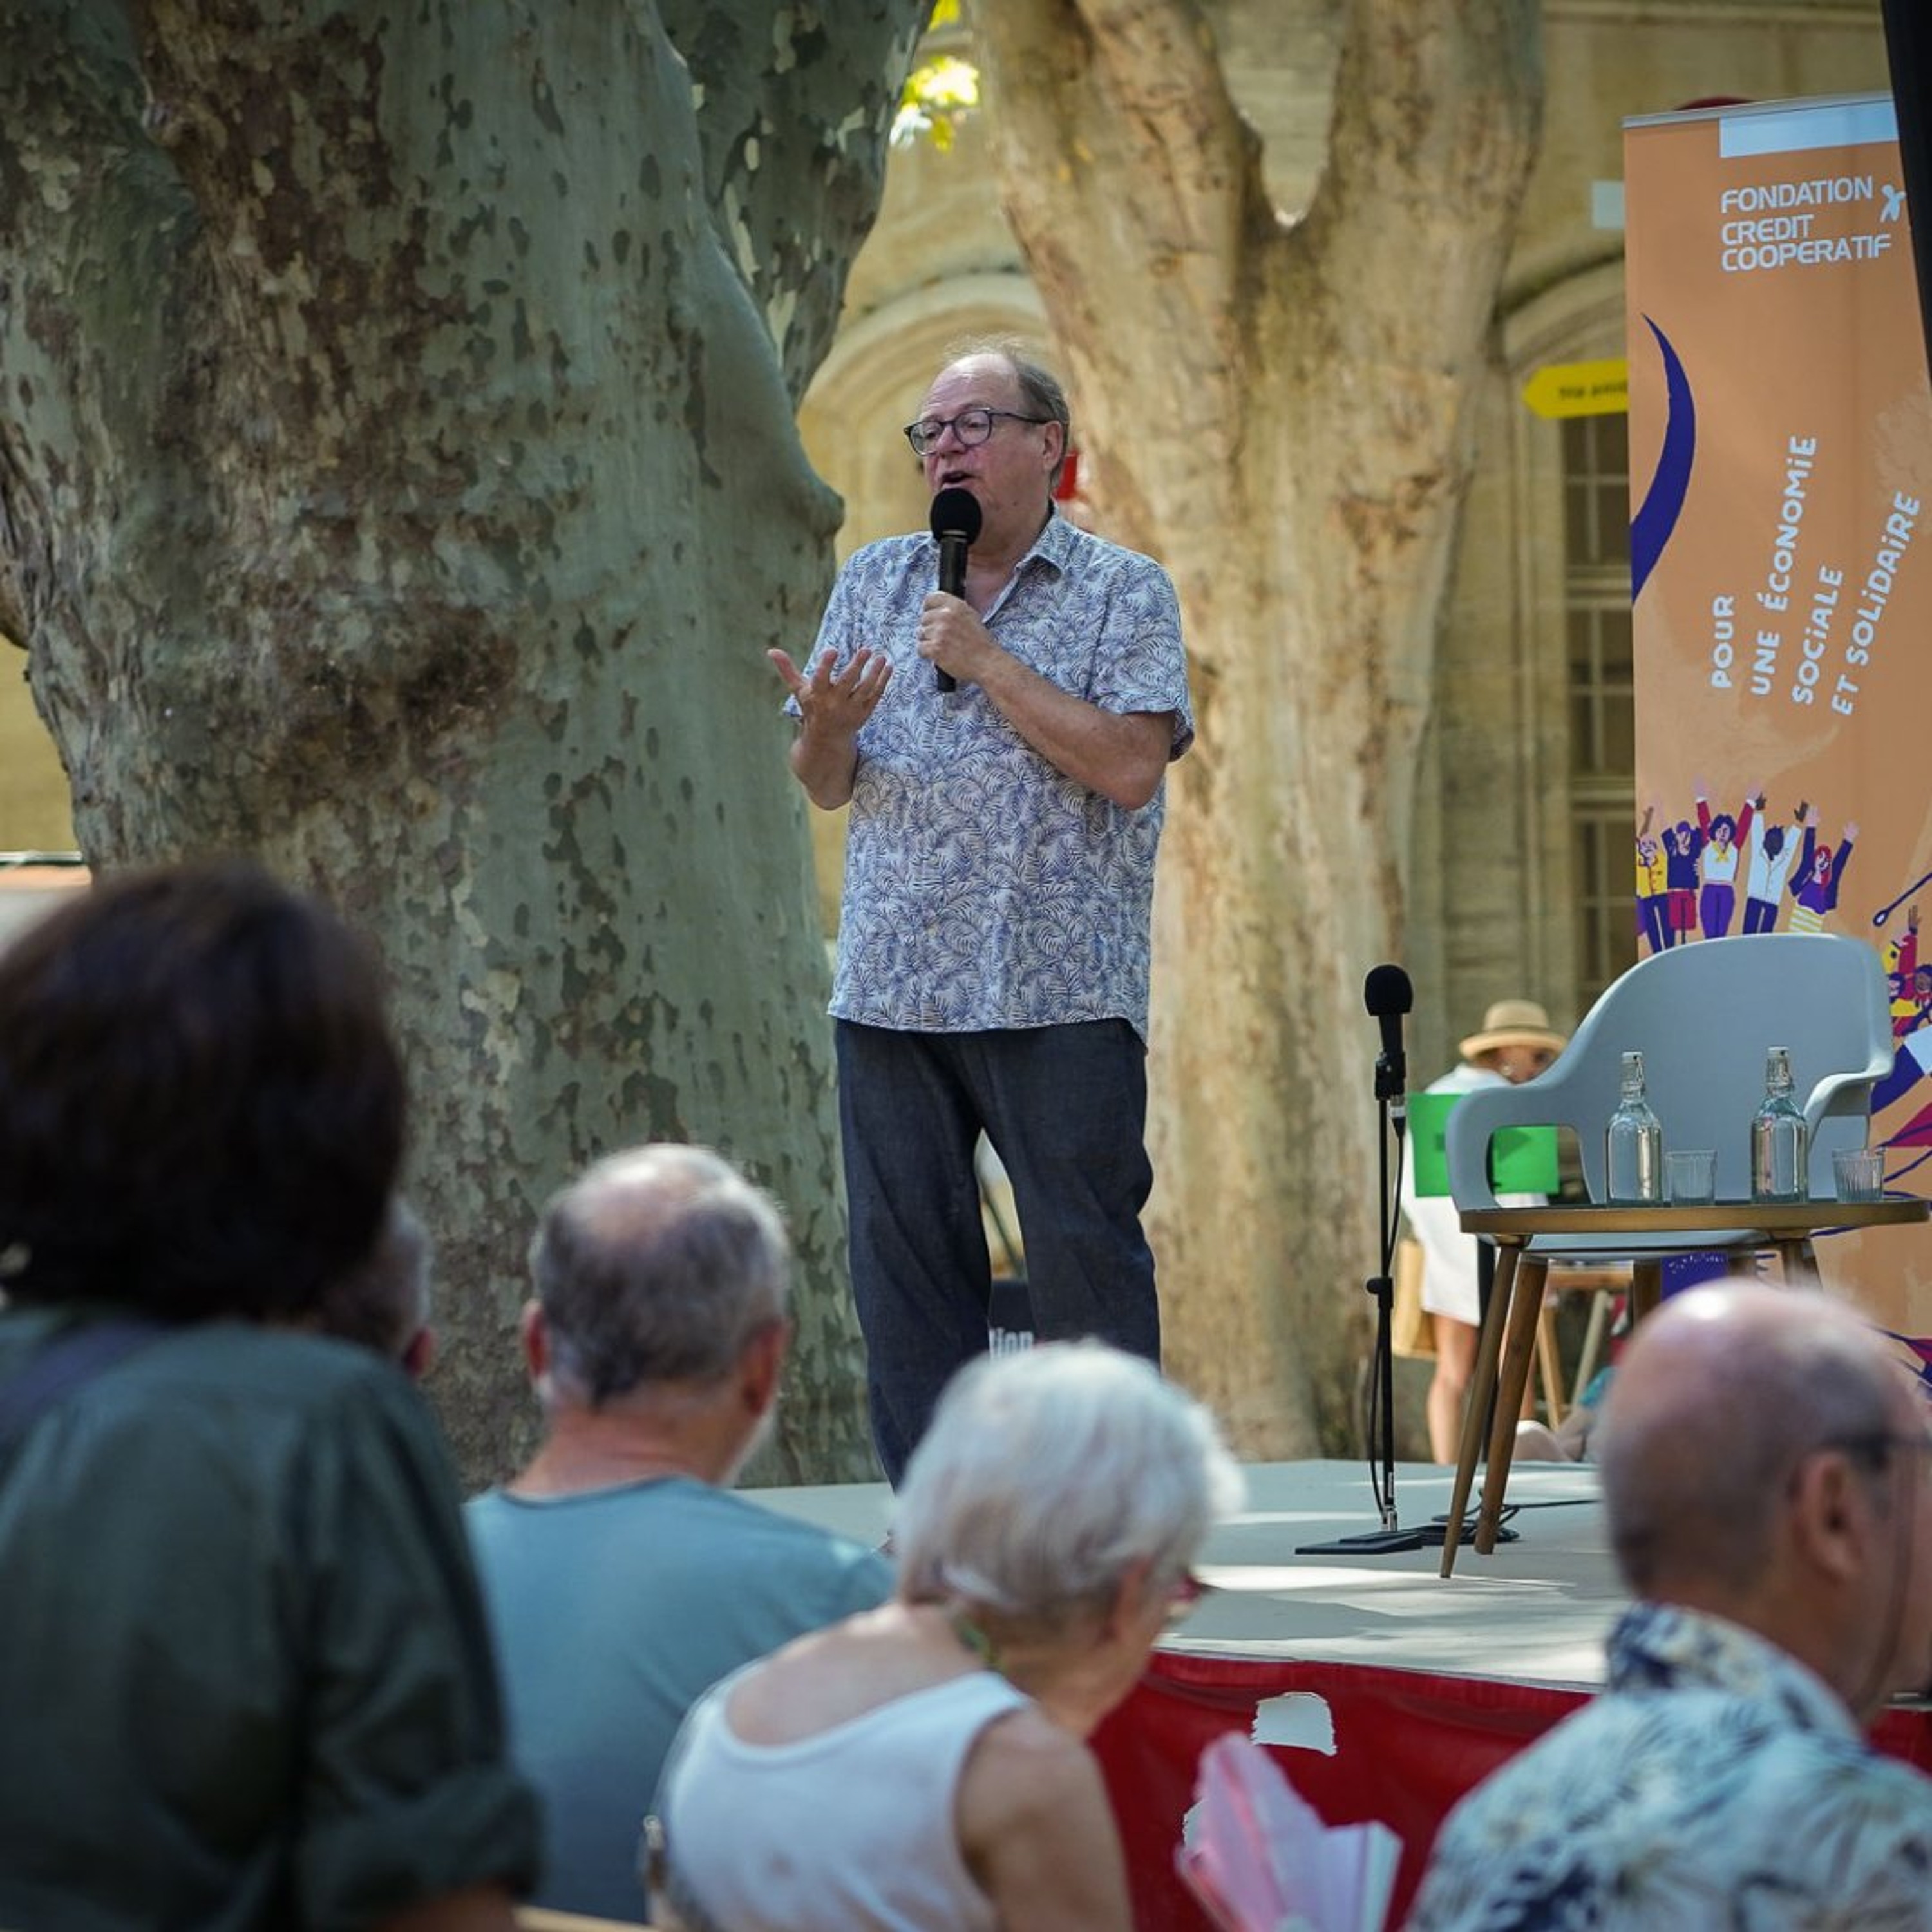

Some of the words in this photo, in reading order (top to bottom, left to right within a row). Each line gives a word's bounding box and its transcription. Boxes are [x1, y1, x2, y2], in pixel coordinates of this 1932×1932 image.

[1721, 176, 1873, 214] FONDATION
[1721, 214, 1814, 246] CREDIT
[1721, 234, 1891, 272] COOPERATIF
[1711, 595, 1734, 688] POUR
[1750, 630, 1780, 696] UNE
[1831, 674, 1859, 716] ET
